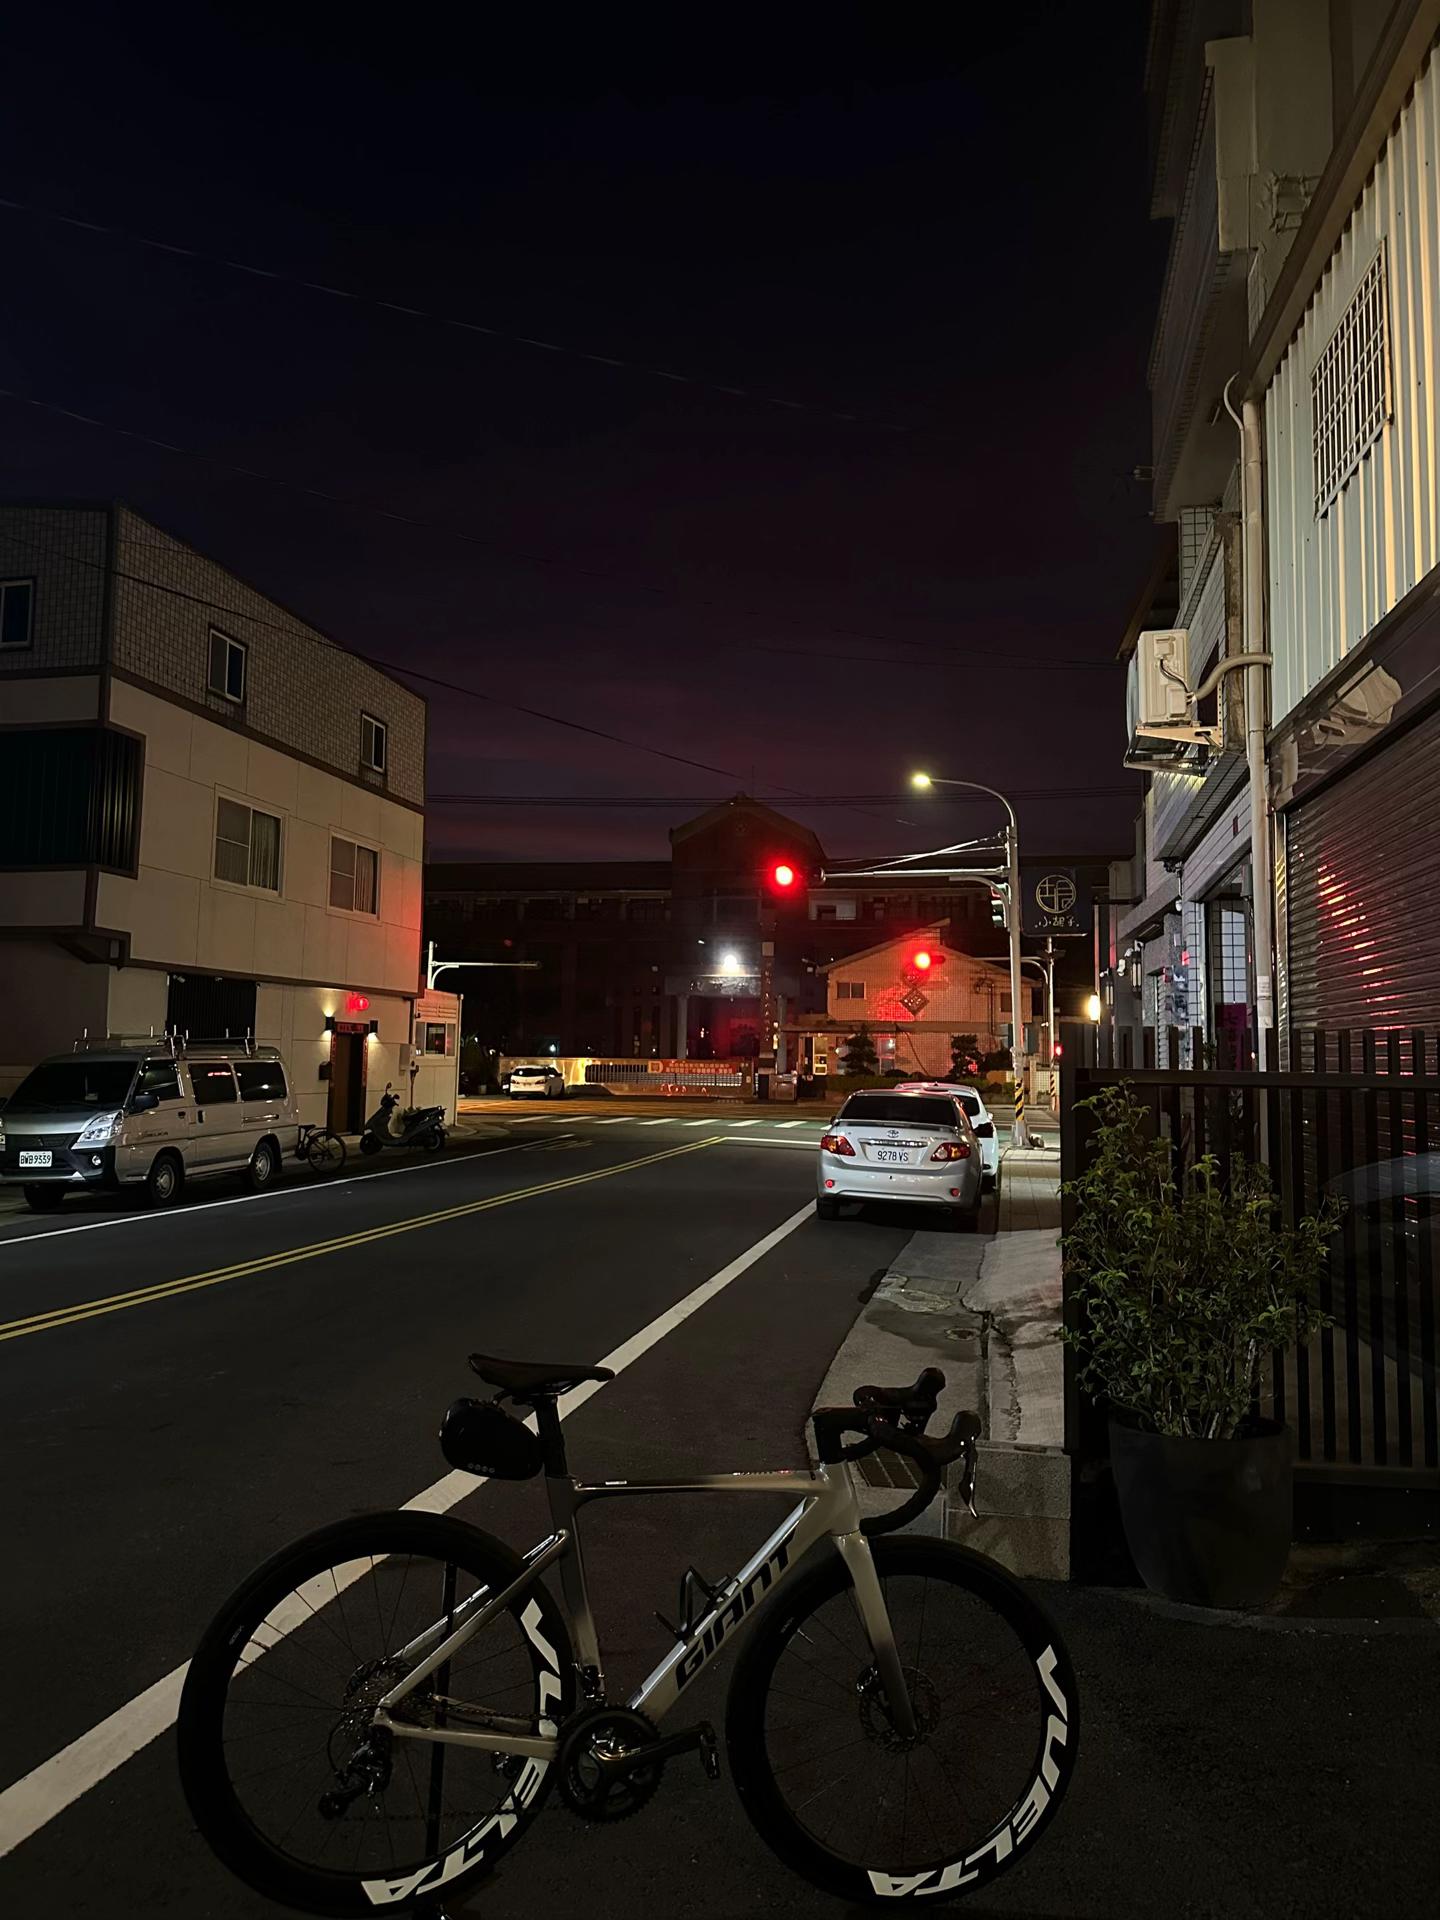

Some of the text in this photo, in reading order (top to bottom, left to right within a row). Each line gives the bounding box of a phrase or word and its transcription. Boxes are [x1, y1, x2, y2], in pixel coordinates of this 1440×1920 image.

[877, 1150, 909, 1162] 9278 VS
[675, 1527, 796, 1690] GIANT
